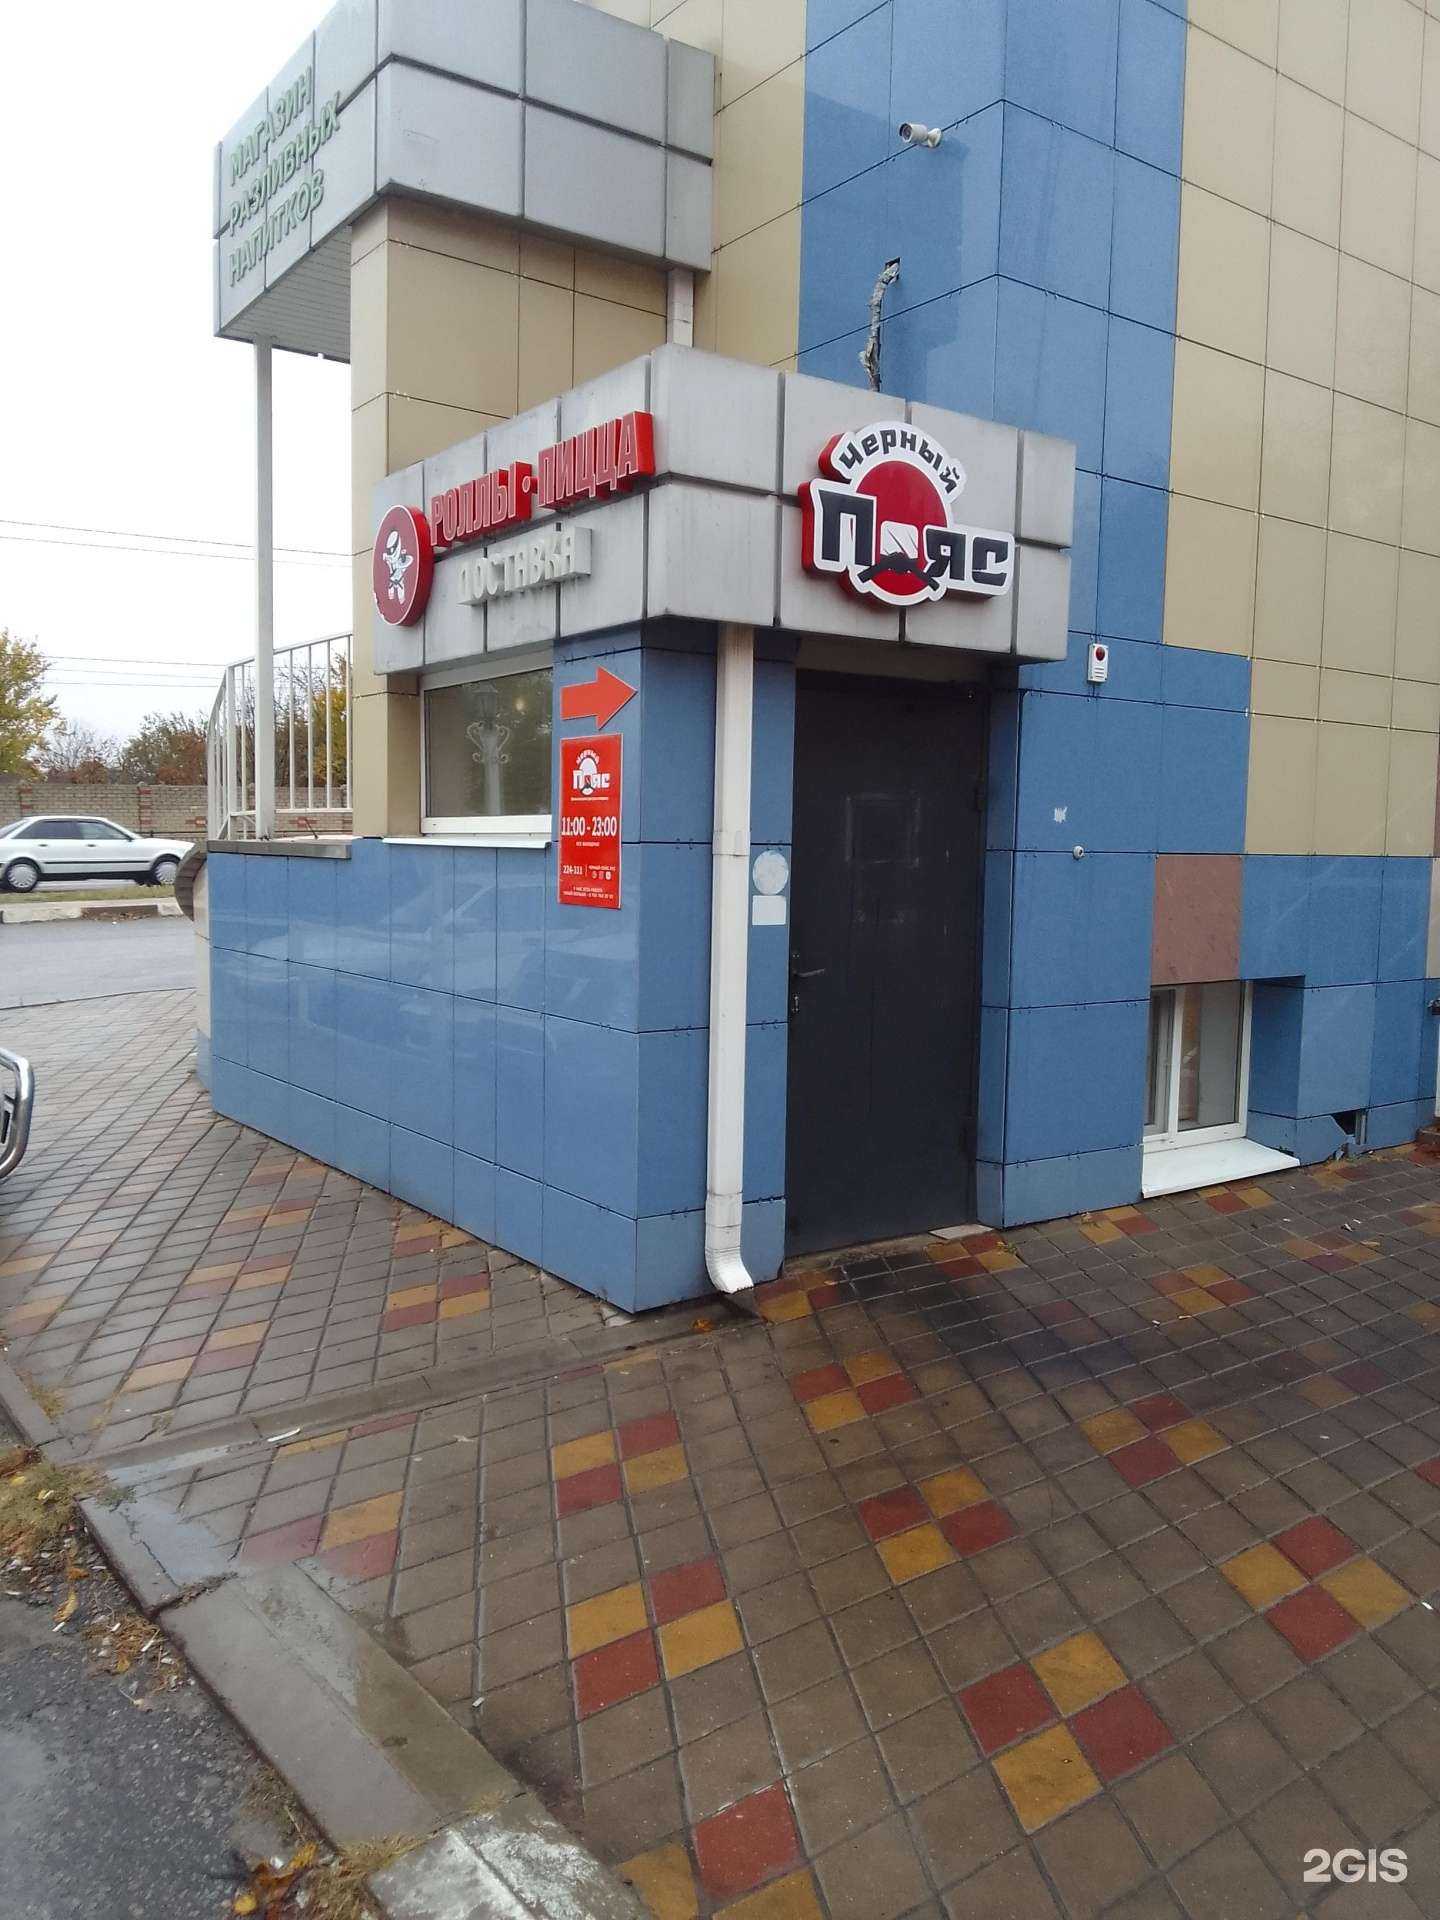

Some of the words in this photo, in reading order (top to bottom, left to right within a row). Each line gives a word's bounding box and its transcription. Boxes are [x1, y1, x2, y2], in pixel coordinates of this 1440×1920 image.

[229, 90, 341, 237] РАЗЛИВНЫХ
[231, 66, 312, 187] МАГАЗИН
[229, 168, 325, 287] НАПИТКОВ
[430, 461, 524, 547] РОЛЛЫ
[538, 411, 646, 507] ПИЦЦА
[561, 816, 586, 836] 11:00
[591, 816, 618, 837] 23:00
